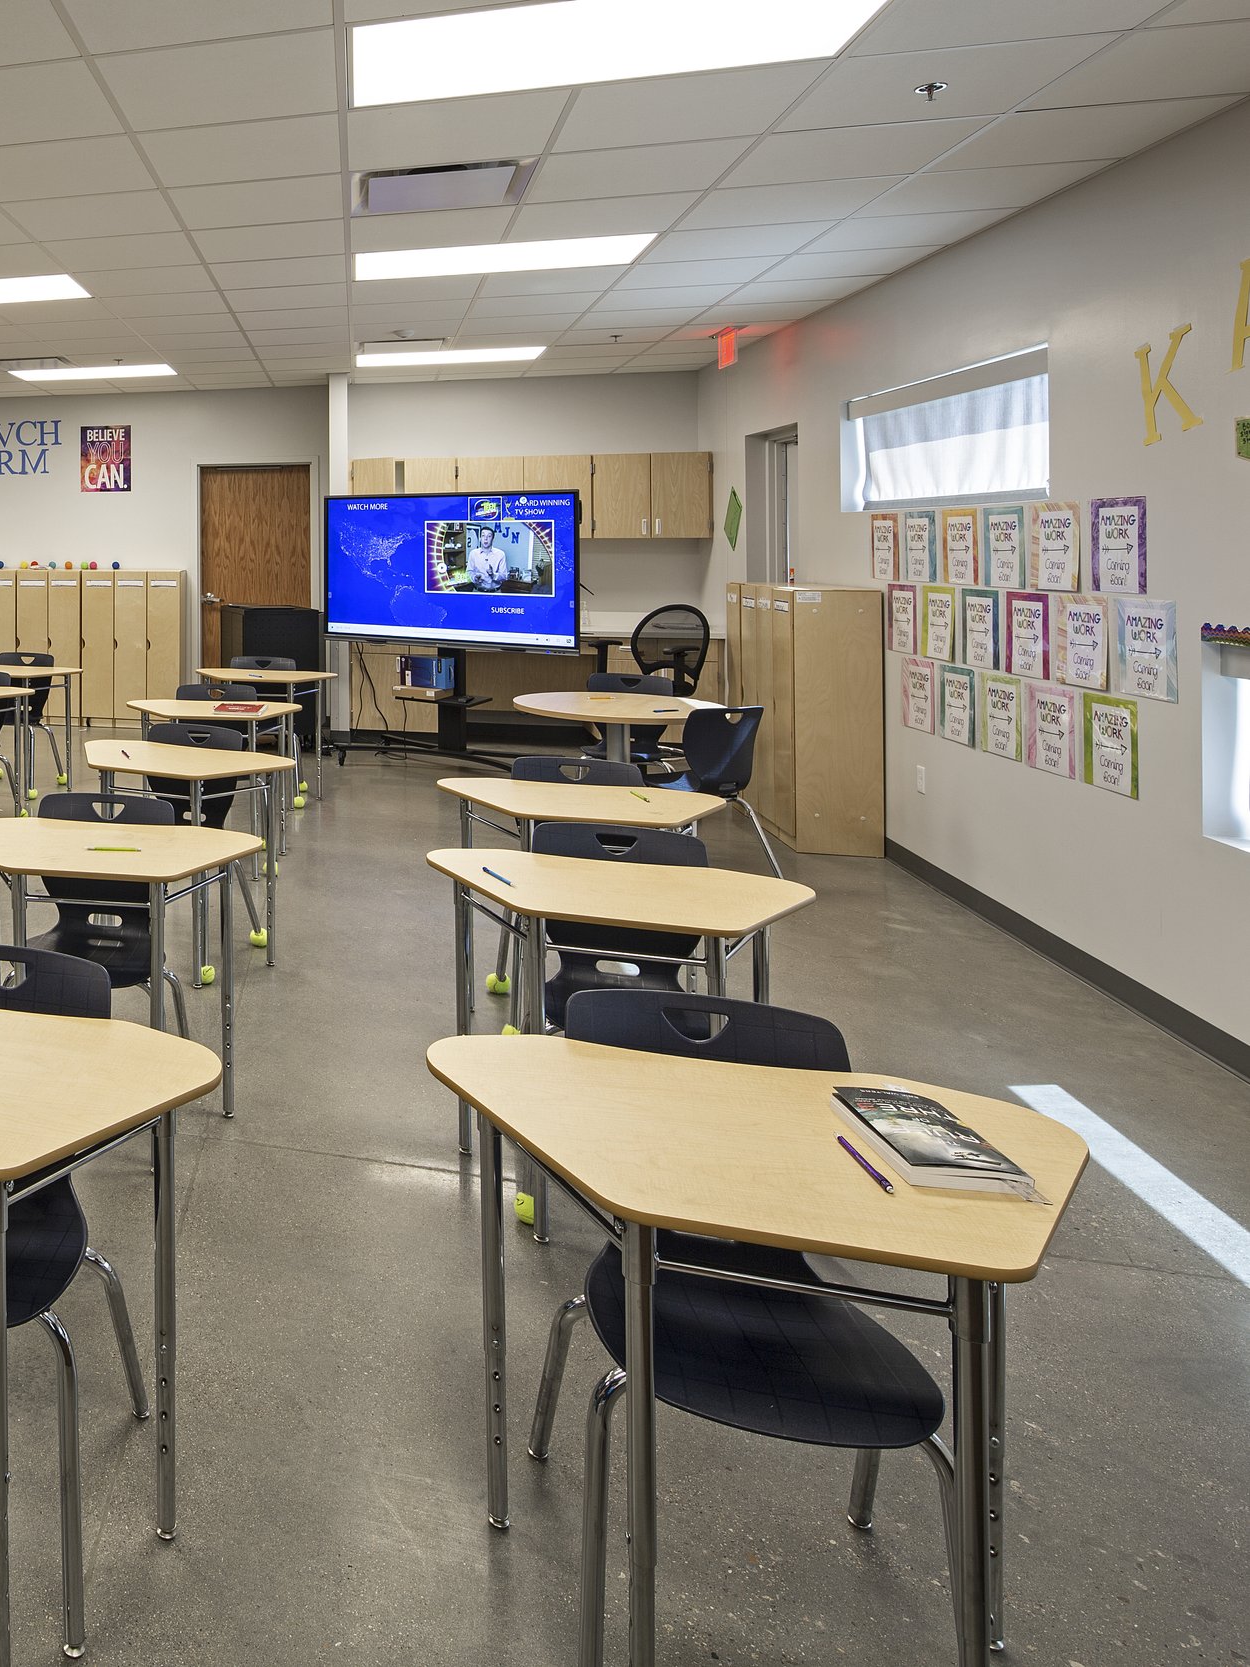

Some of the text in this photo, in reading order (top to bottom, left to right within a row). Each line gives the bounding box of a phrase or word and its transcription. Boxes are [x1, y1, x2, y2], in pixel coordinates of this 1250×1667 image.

[86, 429, 125, 441] BELIEVE
[86, 442, 123, 463] YOU
[85, 464, 128, 489] CAN.
[347, 503, 369, 511] WATCH
[539, 498, 571, 507] WINNING
[514, 508, 546, 516] TV SHOW
[990, 521, 1017, 531] AMAZING
[1040, 518, 1071, 529] AMAZING
[1100, 514, 1136, 526] AMAZING
[948, 522, 971, 532] AMAZING
[1105, 527, 1129, 539] WORK
[951, 532, 967, 542] WORK
[994, 532, 1013, 542] WORK
[1044, 530, 1066, 541] WORK
[1045, 558, 1065, 573] Coming
[1106, 558, 1130, 575] Coming
[490, 606, 525, 615] SUBSCRIBE
[968, 602, 991, 614] AMAZING
[1014, 606, 1041, 619] AMAZING
[970, 613, 987, 625] WORK
[1068, 611, 1101, 624] AMAZING
[1125, 615, 1164, 630] AMAZING
[1016, 619, 1036, 630] WORK
[1073, 623, 1095, 637] WORK
[1131, 629, 1158, 644] WORK
[1018, 645, 1036, 662] Coming
[1073, 652, 1094, 670] Coming
[1133, 660, 1158, 680] Coming
[946, 678, 968, 691] AMAZING
[949, 689, 965, 701] WORK
[987, 687, 1015, 702] AMAZING
[991, 699, 1010, 712] WORK
[1037, 698, 1066, 714] AMAZING
[1040, 711, 1061, 726] WORK
[1094, 710, 1129, 727] AMAZING
[1099, 724, 1124, 740] WORK
[1042, 739, 1062, 759] Coming
[1099, 754, 1124, 776] Coming
